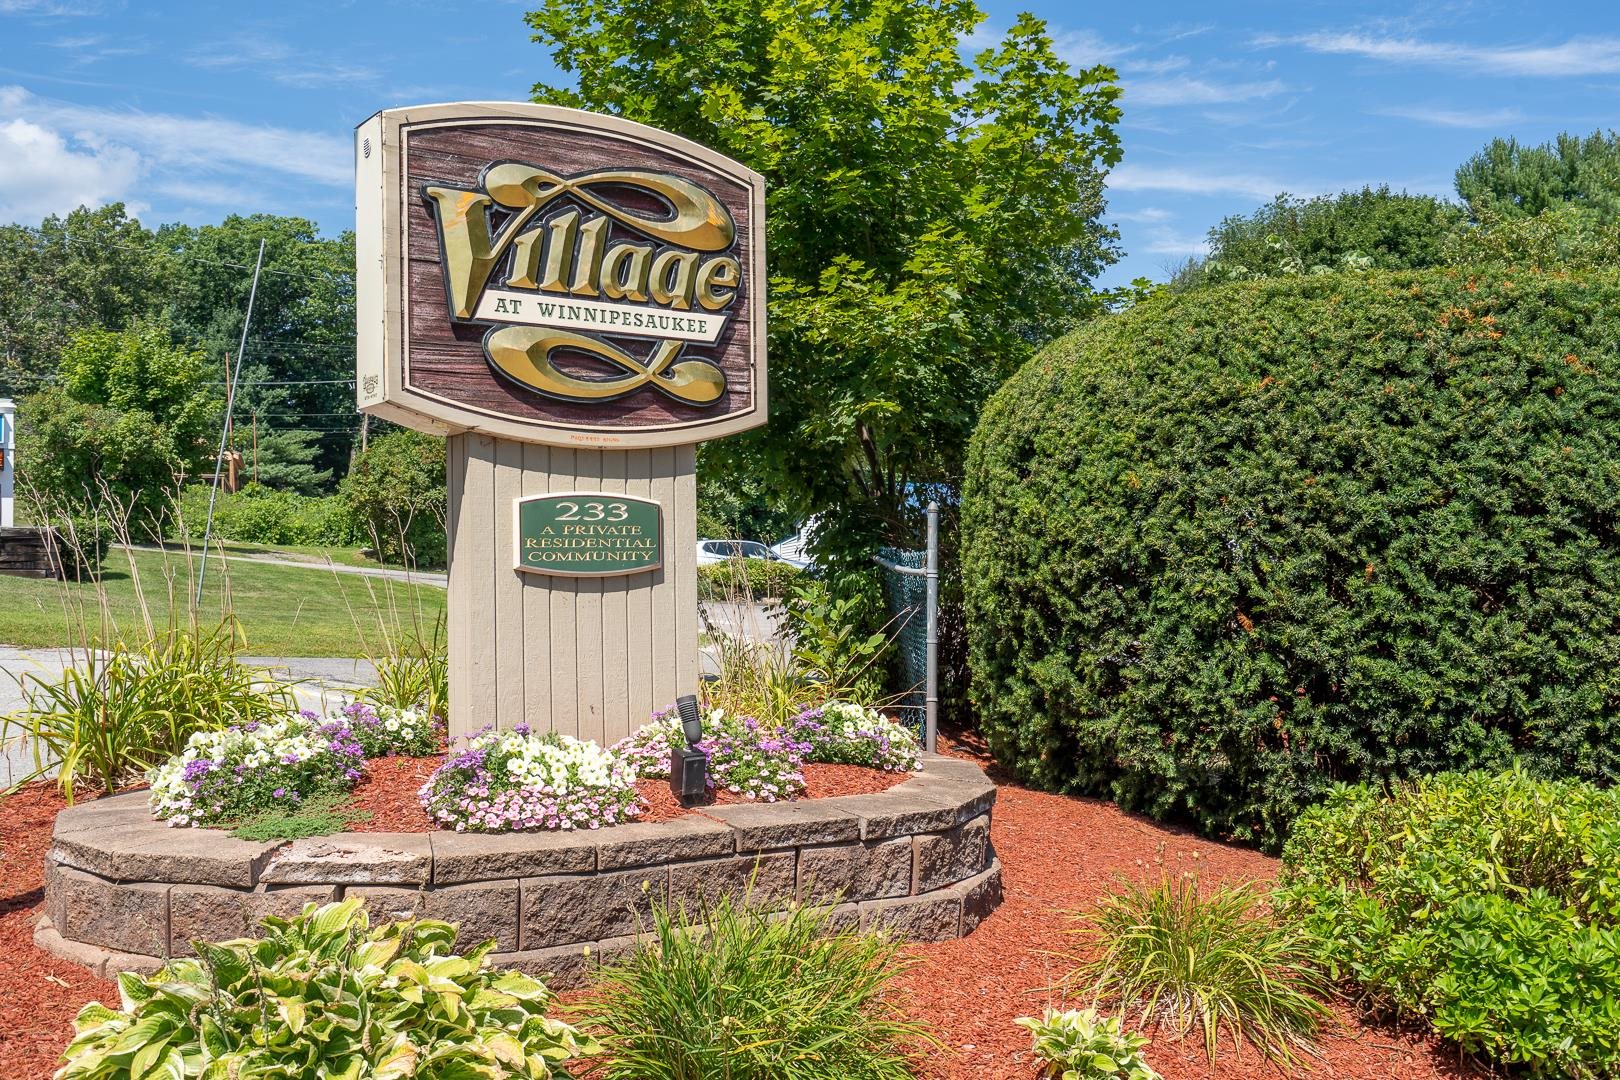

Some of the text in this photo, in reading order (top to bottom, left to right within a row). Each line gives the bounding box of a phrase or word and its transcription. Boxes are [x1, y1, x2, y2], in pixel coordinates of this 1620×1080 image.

[424, 164, 740, 320] Village
[494, 297, 708, 335] AT WINNIPESAUKEE
[555, 502, 629, 521] 233
[541, 524, 642, 535] A PRIVATE
[525, 537, 657, 549] RESIDENTIAL
[528, 551, 654, 562] COMMUNITY
